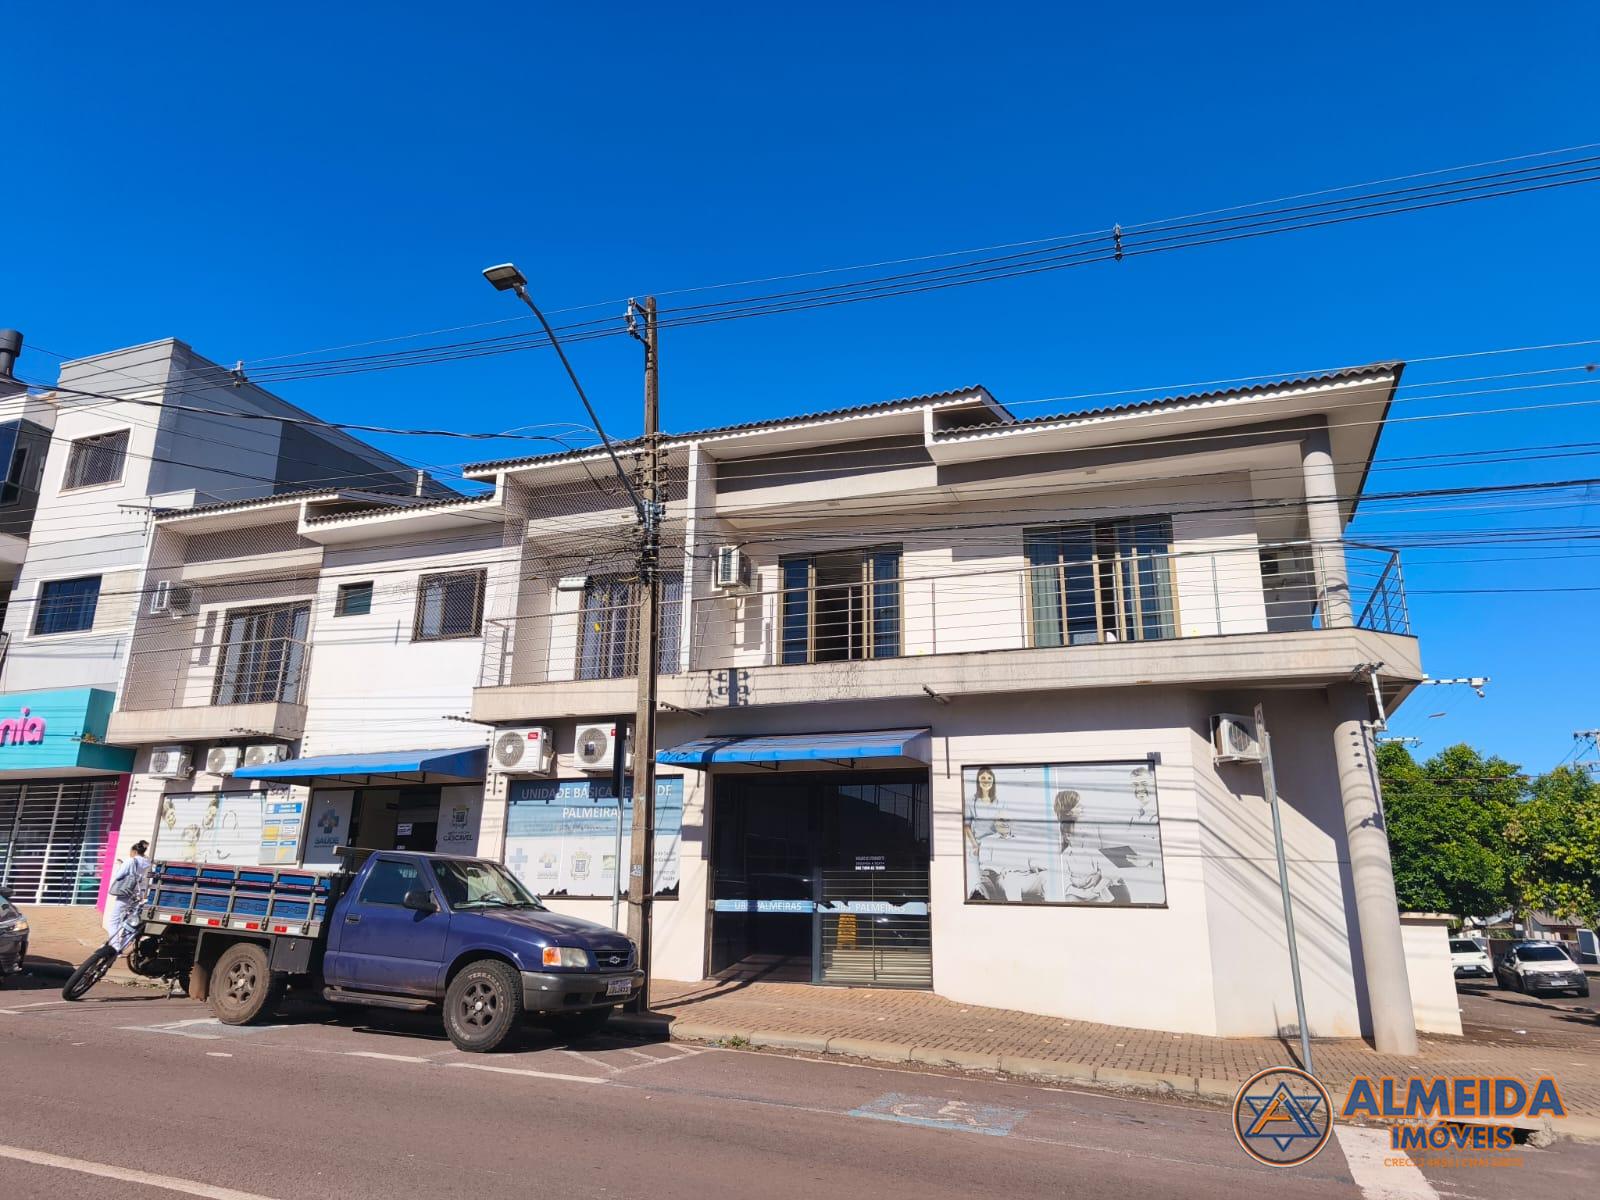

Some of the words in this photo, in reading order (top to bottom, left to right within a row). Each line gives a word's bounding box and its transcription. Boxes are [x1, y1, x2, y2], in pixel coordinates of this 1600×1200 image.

[521, 786, 571, 800] UNIDADE
[573, 784, 613, 798] BÁSICA
[562, 806, 625, 819] PALMEIRA
